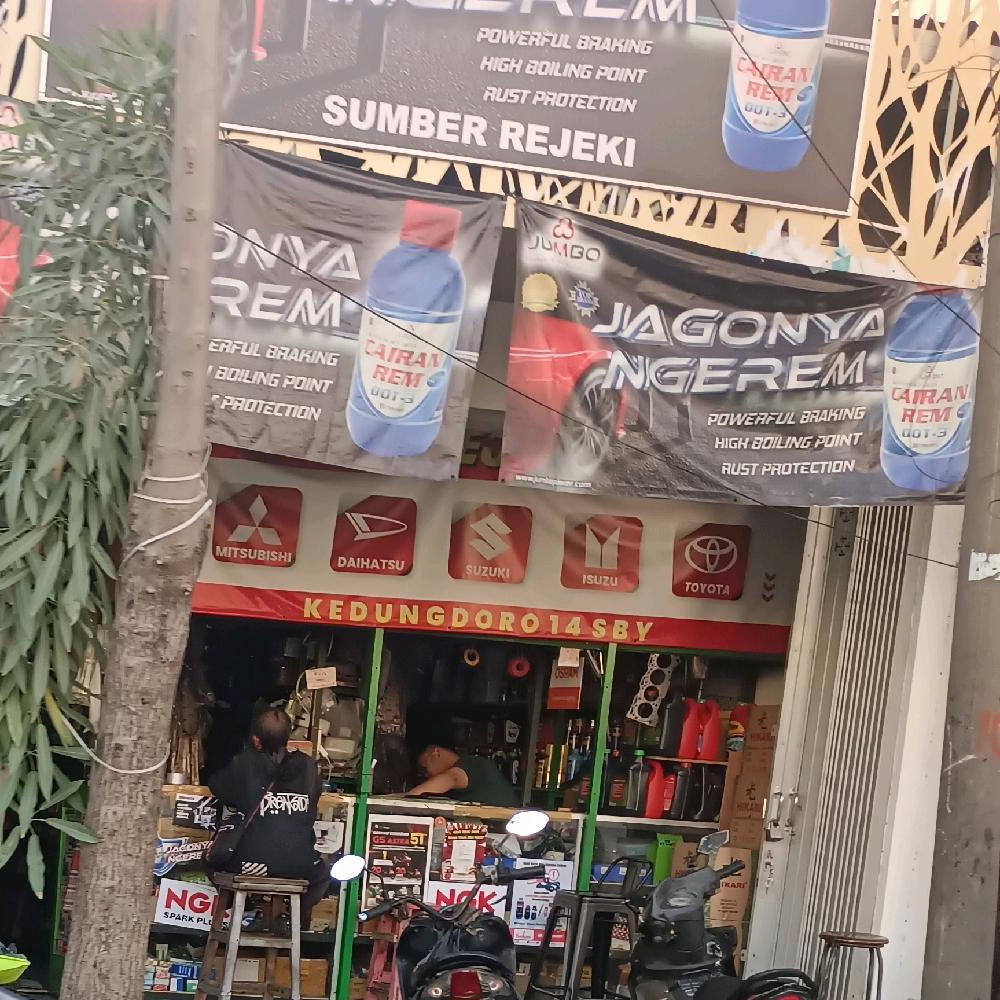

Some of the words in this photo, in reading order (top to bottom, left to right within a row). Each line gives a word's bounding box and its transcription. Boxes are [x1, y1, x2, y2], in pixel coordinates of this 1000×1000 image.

[477, 27, 571, 49] POWERFUL
[576, 34, 654, 55] BRAKING
[480, 56, 523, 73] HIGH
[525, 60, 594, 79] BOILING
[595, 66, 648, 83] POINT
[737, 57, 811, 82] CAIRAN
[483, 86, 531, 105] RUST
[532, 91, 637, 113] PROTECTION
[746, 81, 794, 102] REM
[322, 95, 488, 147] SUMBER
[499, 120, 636, 167] REJEKI
[528, 236, 600, 261] JUMBO
[591, 303, 885, 348] JAGONYA
[265, 345, 340, 367] BRAKING
[365, 339, 440, 368] CAIRAN
[215, 366, 281, 387] BOILING
[282, 375, 334, 393] POINT
[373, 364, 424, 388] REM
[602, 350, 867, 395] NGEREM
[892, 384, 968, 405] CAIRAN
[220, 396, 322, 421] PROTECTION
[707, 412, 796, 426] POWERFUL
[800, 407, 867, 424] BRAKING
[902, 407, 953, 423] REM
[715, 437, 749, 449] HIGH
[752, 435, 812, 450] BOILING
[815, 432, 863, 447] POINT
[721, 462, 759, 476] RUST
[762, 459, 855, 476] PROTECTION
[216, 546, 292, 563] MITSUBISHI
[337, 557, 405, 571] DAIHATSU
[465, 564, 510, 579] SUZUKI
[582, 574, 618, 587] ISUZU
[685, 582, 730, 596] TOYOTA
[303, 597, 540, 634] KEDUNGDORO
[550, 615, 582, 637] 14
[592, 619, 654, 643] SBY
[164, 911, 194, 923] SPARK
